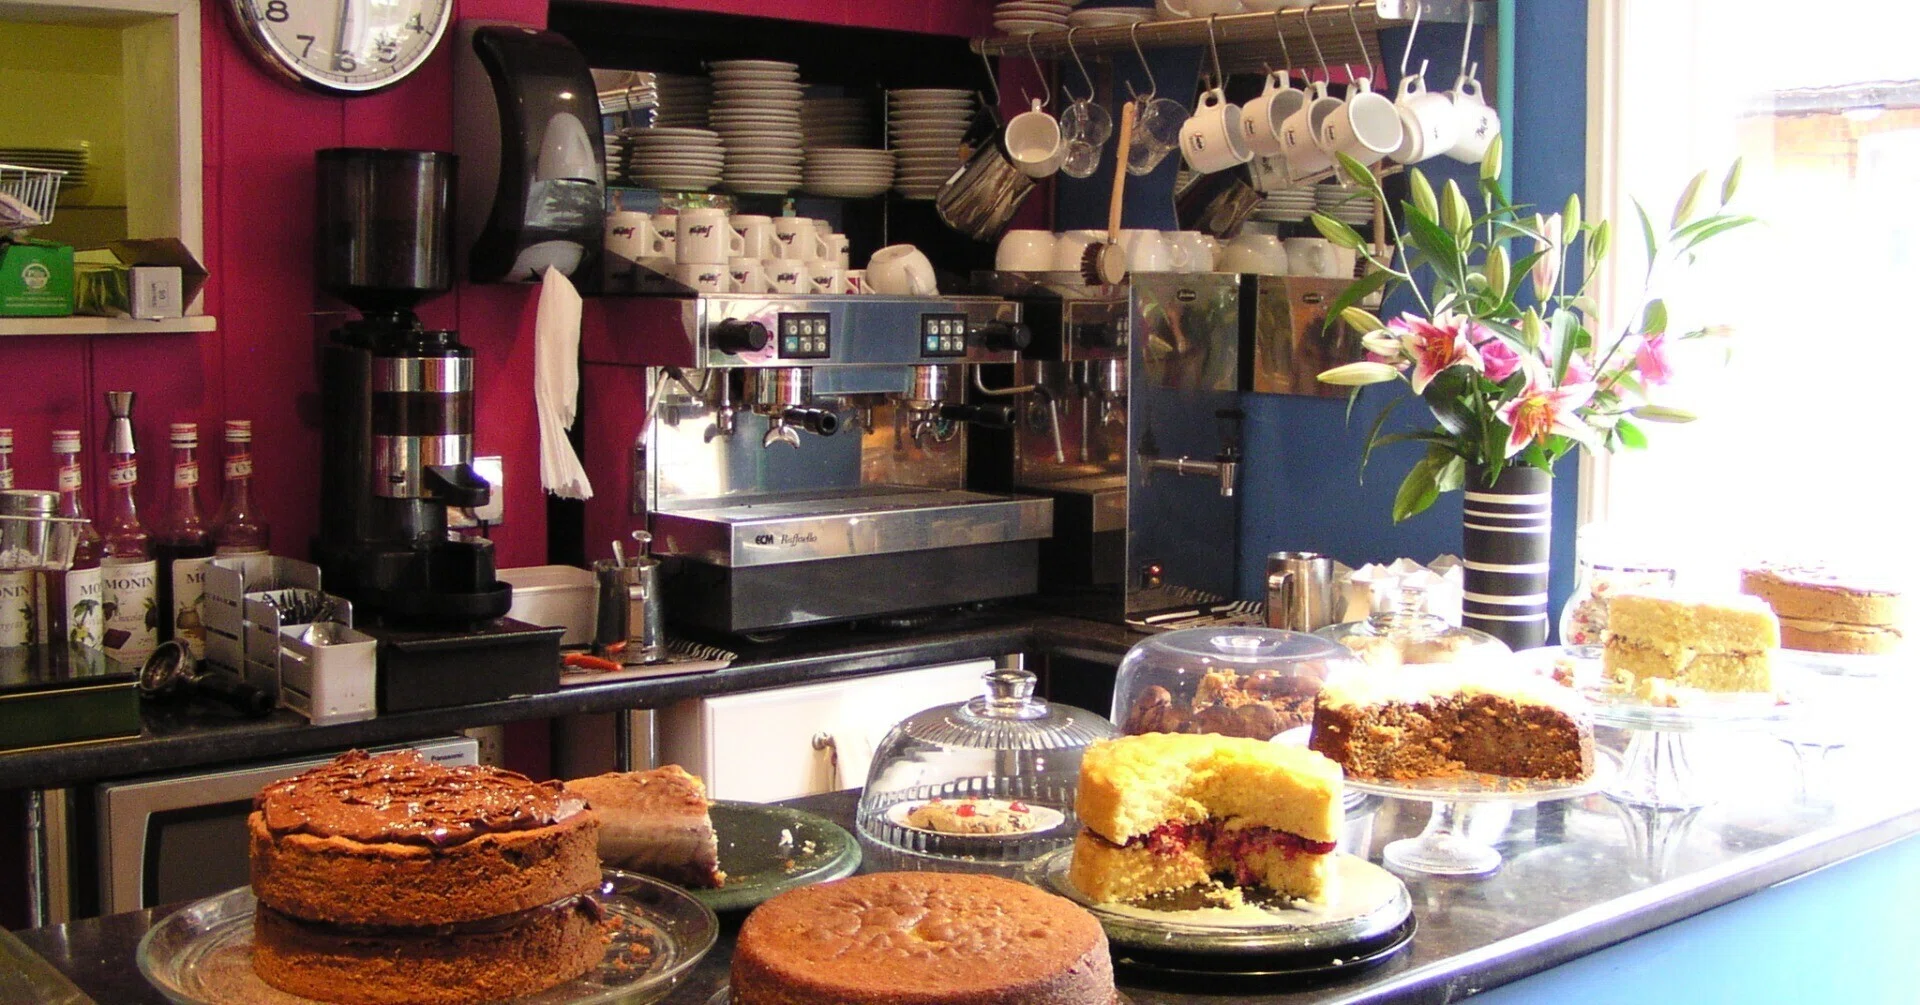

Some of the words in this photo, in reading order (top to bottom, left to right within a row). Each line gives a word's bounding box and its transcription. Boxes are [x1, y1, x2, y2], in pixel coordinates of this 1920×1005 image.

[265, 0, 290, 22] 8
[405, 13, 424, 34] 4
[296, 35, 315, 58] 7
[755, 534, 774, 545] ECM
[105, 576, 154, 590] MONIN
